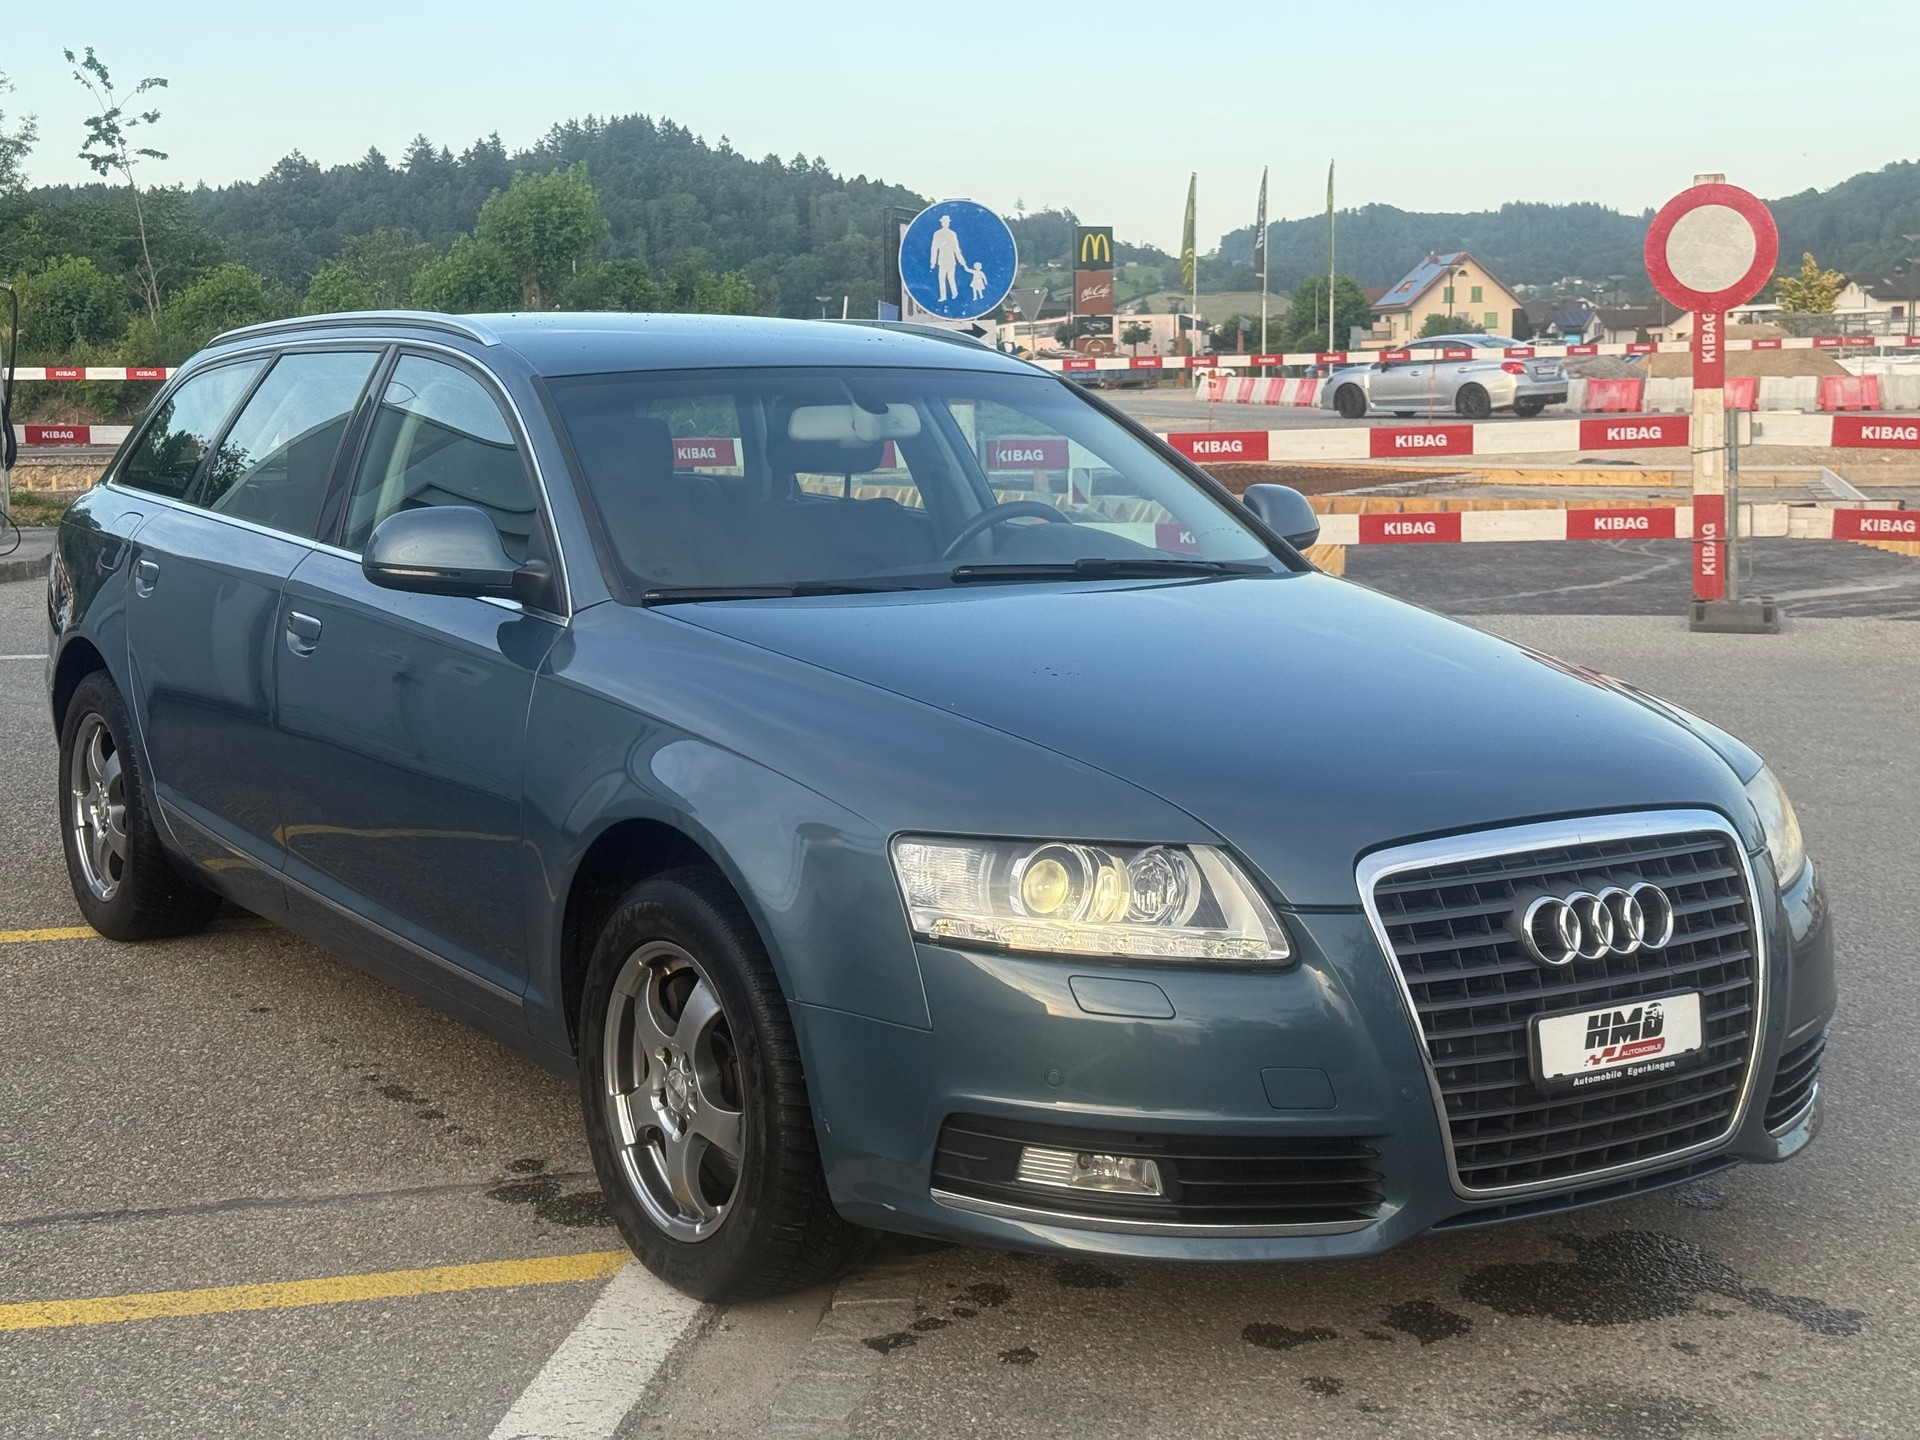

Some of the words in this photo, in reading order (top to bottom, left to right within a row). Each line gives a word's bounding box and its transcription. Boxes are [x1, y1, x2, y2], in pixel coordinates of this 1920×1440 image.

[41, 430, 75, 440] KIBAG
[1607, 425, 1662, 441] KIBAG
[1861, 425, 1918, 440] KIBAG
[1192, 440, 1243, 454] KIBAG
[1395, 433, 1448, 448] KIBAG
[677, 447, 717, 460] KIBAG
[998, 448, 1044, 462] KIBAG
[1384, 521, 1436, 535] KIBAG
[1594, 516, 1649, 531] KIBAG
[1859, 518, 1916, 533] KIBAG
[1701, 522, 1716, 576] KIBAG
[1622, 1043, 1662, 1057] AUTOMOBILE
[1573, 1071, 1622, 1086] Automobile
[1627, 1061, 1675, 1076] Egerkingen
